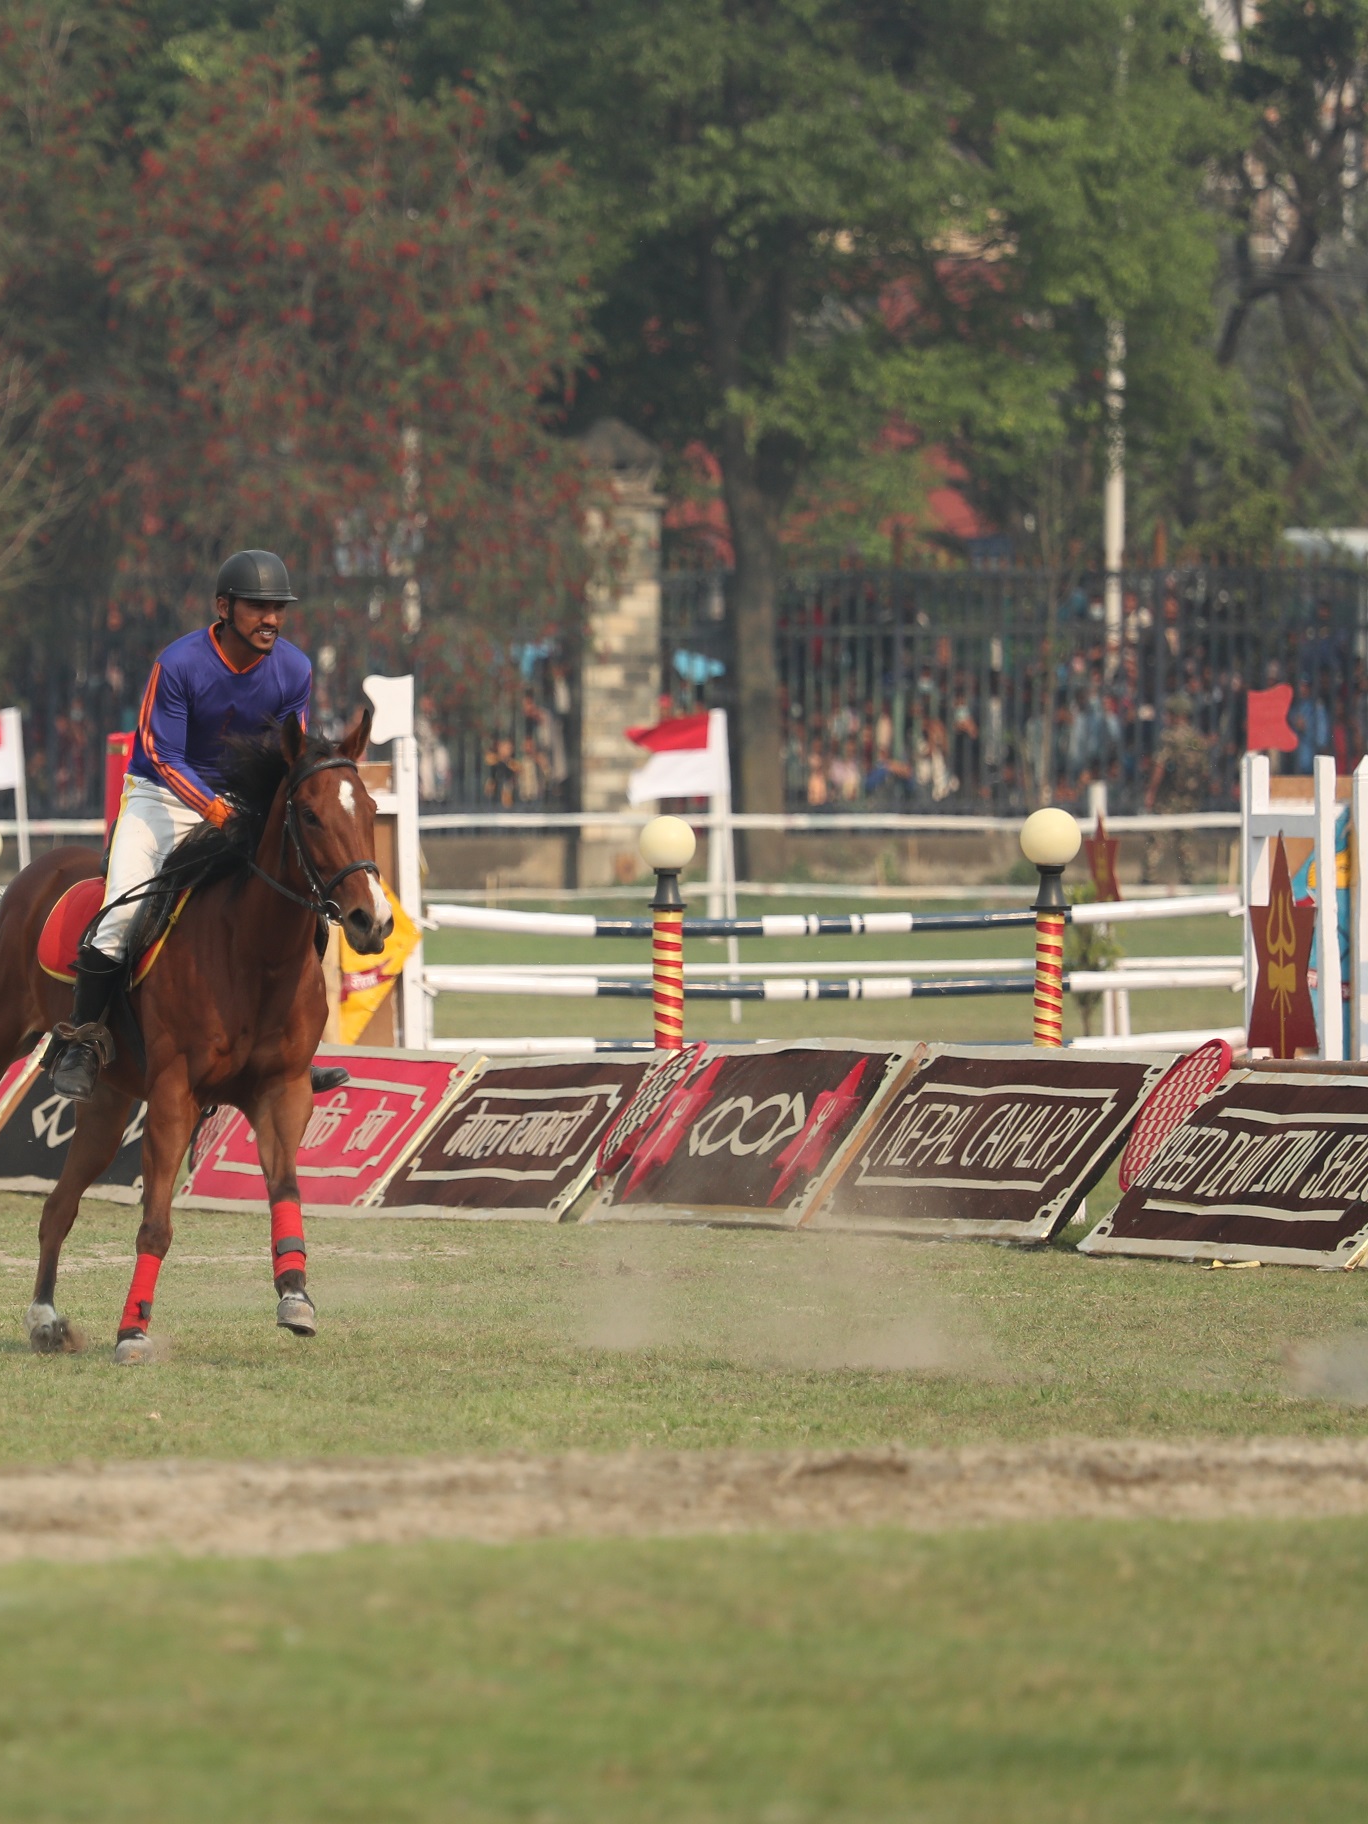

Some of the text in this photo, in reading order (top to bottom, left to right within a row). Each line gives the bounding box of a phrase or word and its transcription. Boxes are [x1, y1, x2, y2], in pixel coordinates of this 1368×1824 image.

[342, 1096, 398, 1154] सेवा
[443, 1100, 521, 1159] नेपाल
[873, 1103, 1098, 1169] NEPAL CAVALRY
[1135, 1124, 1368, 1203] SPEED DEVOTION SERVI
